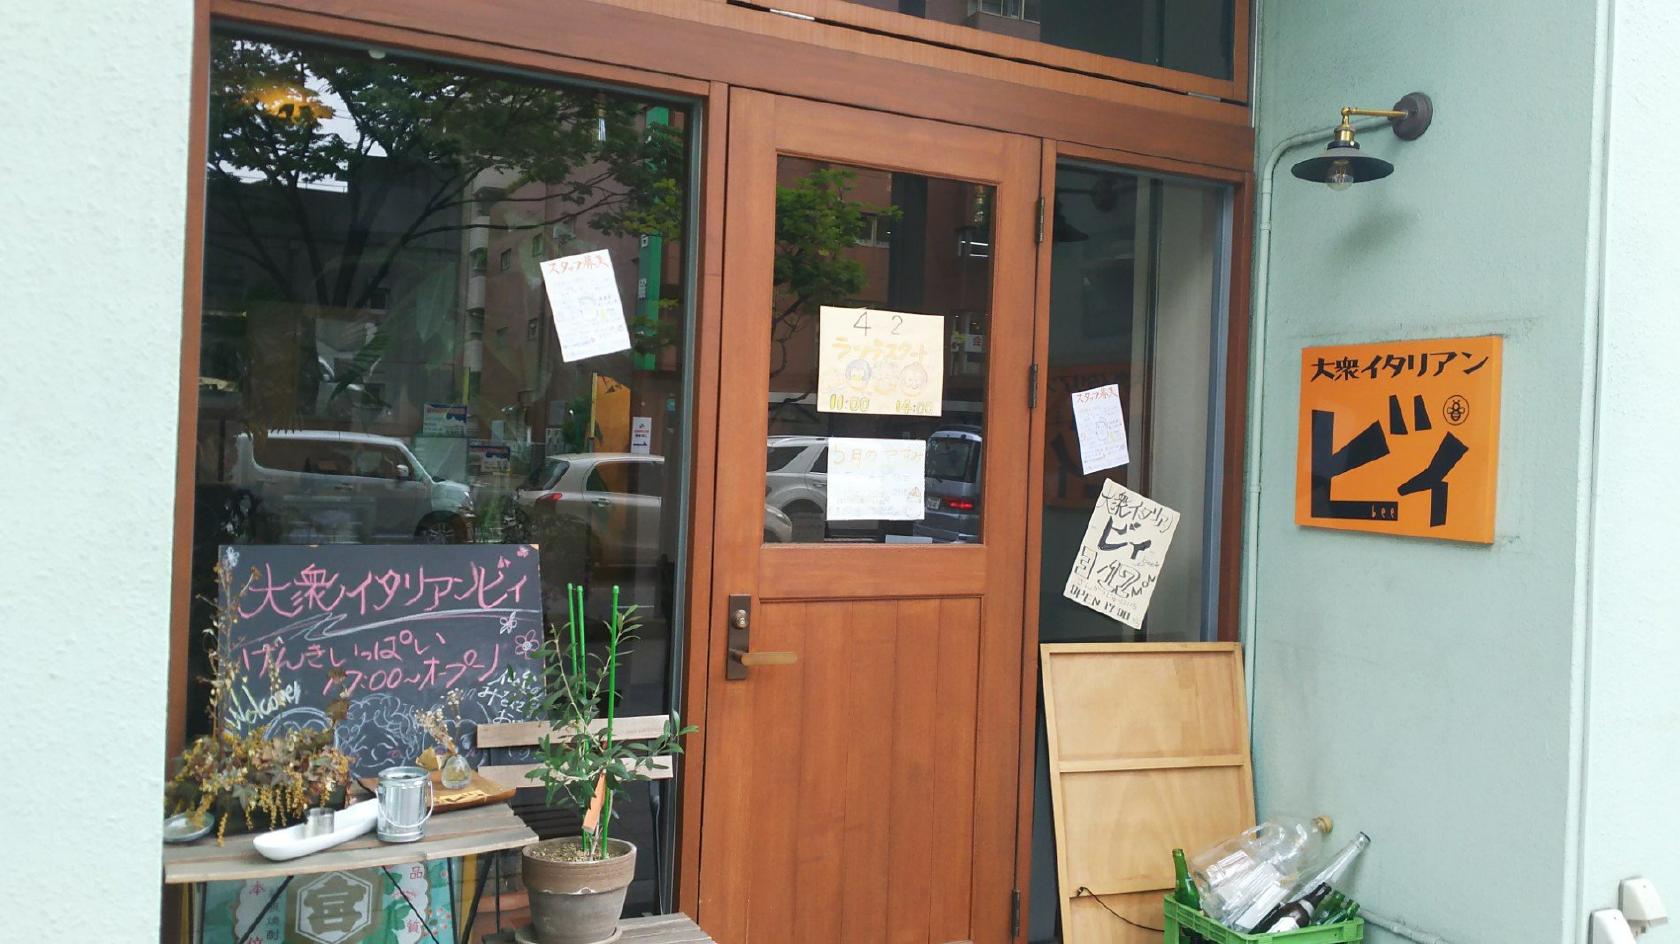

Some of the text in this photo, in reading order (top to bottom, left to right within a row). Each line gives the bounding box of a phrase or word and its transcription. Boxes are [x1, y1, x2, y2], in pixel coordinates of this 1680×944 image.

[853, 311, 903, 336] 4 2
[1310, 352, 1489, 383] 大衆イタリアン
[830, 393, 870, 411] 11:00
[1311, 394, 1469, 528] ビィ
[1371, 506, 1395, 518] bee
[1098, 516, 1152, 560] ビィ
[238, 557, 527, 618] 大衆イタリアンビィ
[1070, 584, 1101, 606] OPEN
[1131, 574, 1156, 597] MON
[224, 681, 301, 731] Welcoe!
